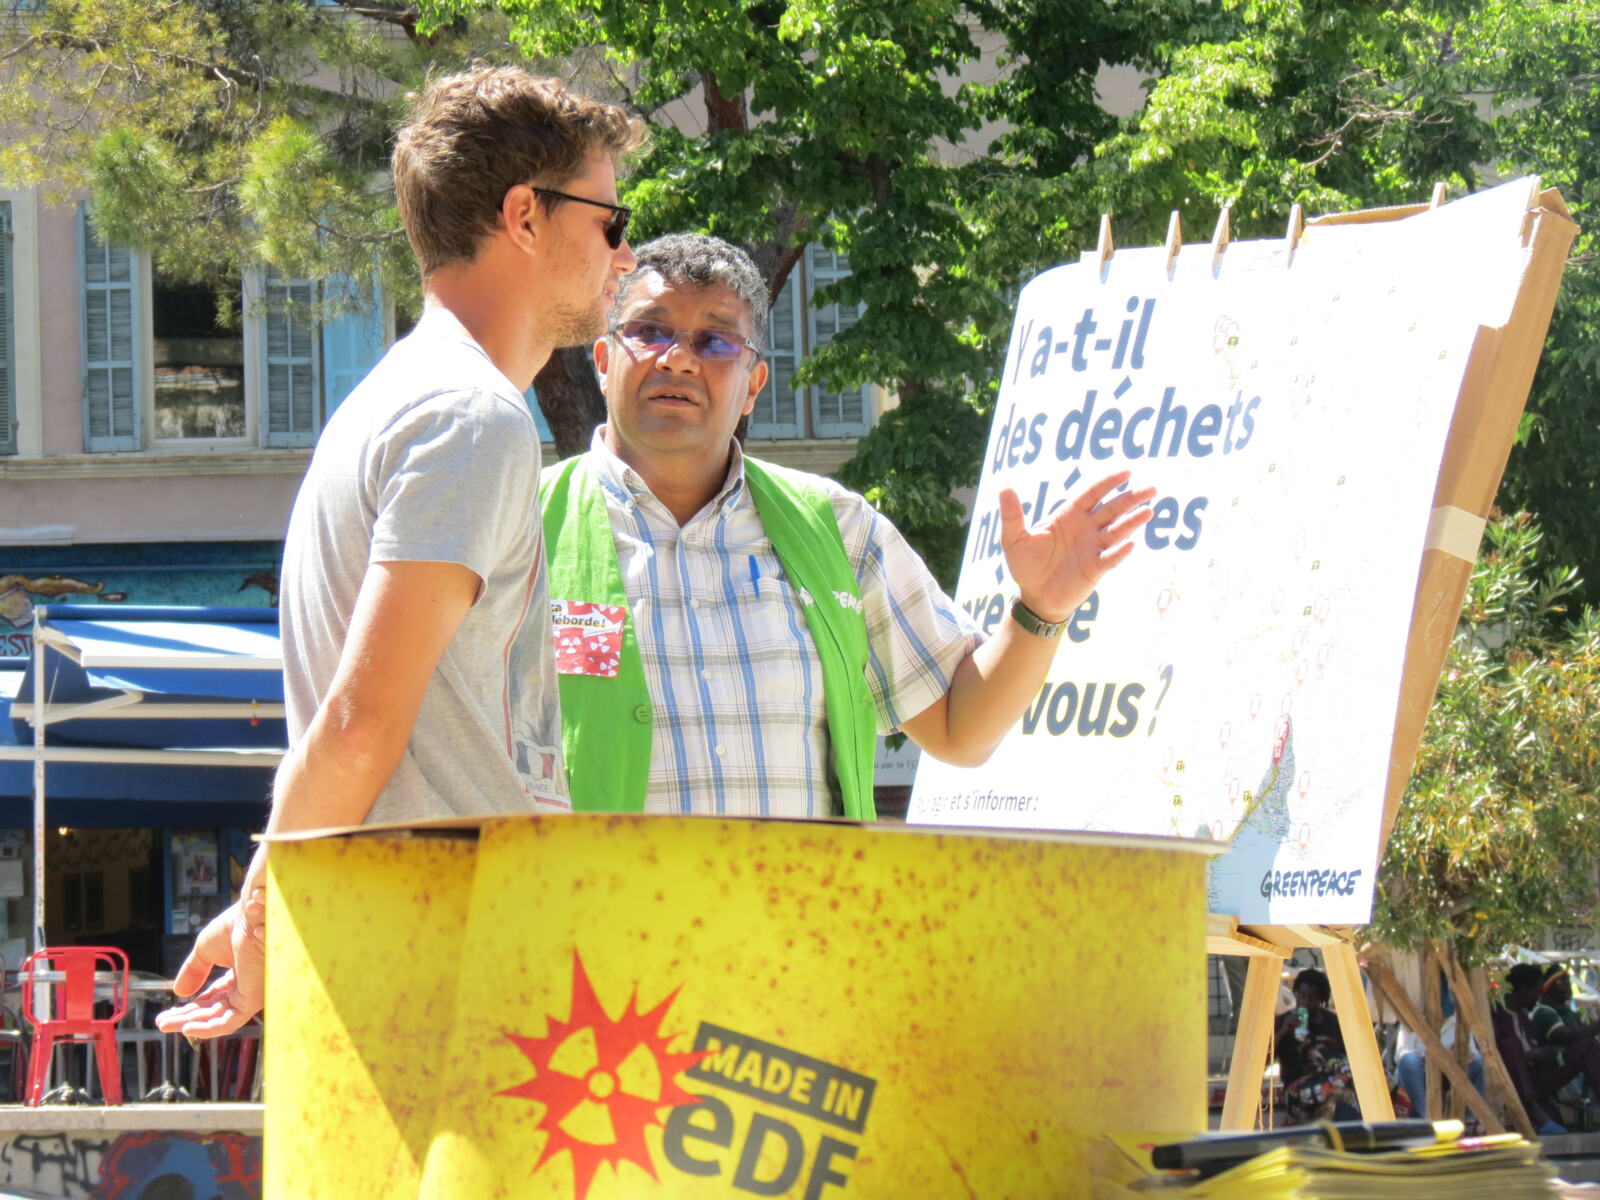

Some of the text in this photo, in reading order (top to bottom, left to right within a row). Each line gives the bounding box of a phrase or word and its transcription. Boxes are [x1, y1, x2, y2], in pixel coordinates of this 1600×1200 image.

[1013, 295, 1157, 386] Y a-t-il
[992, 375, 1261, 475] des déchets
[1260, 868, 1362, 902] GREENPEACE
[701, 1037, 865, 1121] MADE IN
[662, 1093, 859, 1200] eDF
